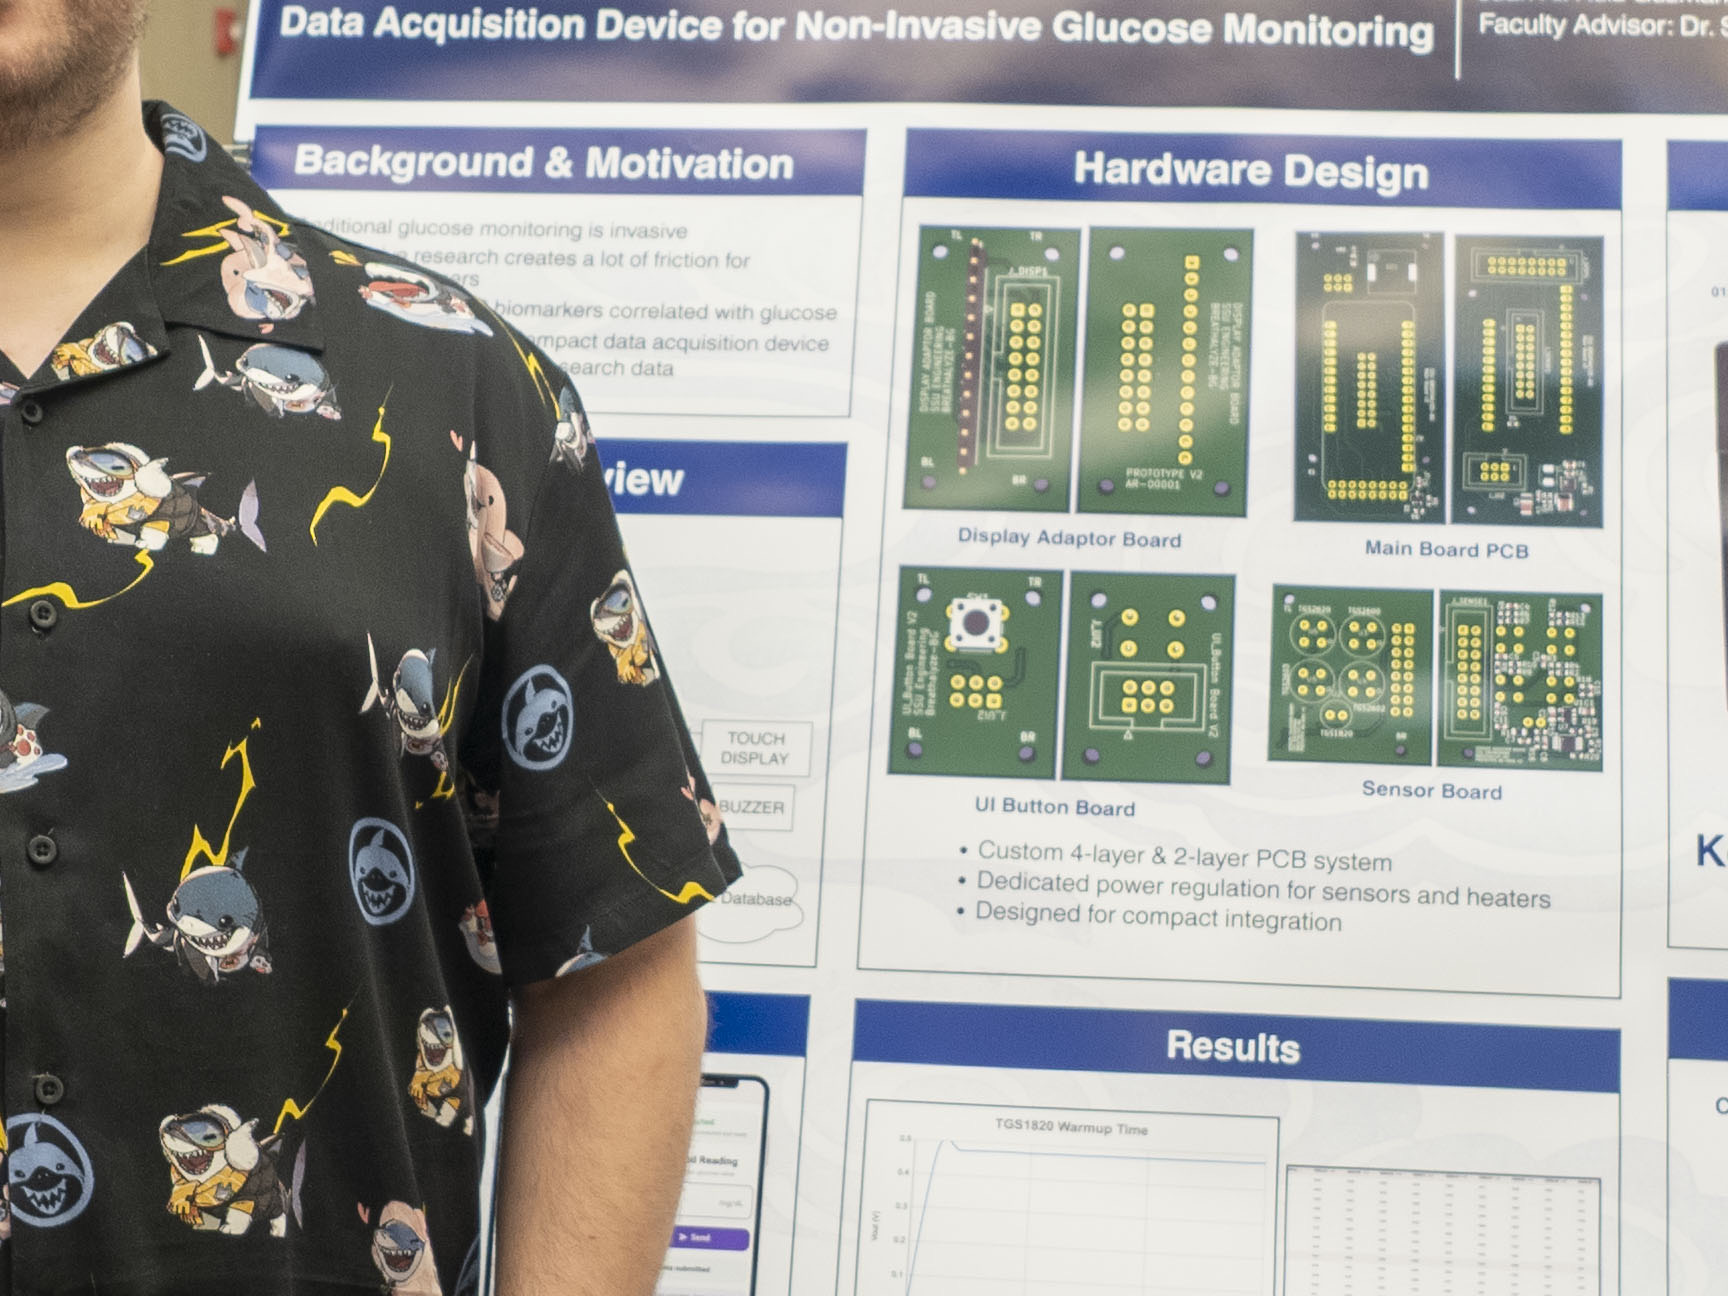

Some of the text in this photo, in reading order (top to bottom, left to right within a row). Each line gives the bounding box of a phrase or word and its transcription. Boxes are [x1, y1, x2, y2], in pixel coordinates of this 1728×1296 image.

[279, 4, 1435, 55] Data Acquisition Device for Non-Invasive Glucose Monitoring
[1479, 11, 1568, 41] Faculty
[1572, 12, 1674, 37] Advisor:
[1679, 14, 1715, 37] Dr.
[294, 143, 794, 185] Background & Motivation
[1074, 150, 1429, 199] Hardware Design
[397, 219, 689, 242] glucose monitoring is invasive
[958, 526, 1182, 550] Display Adaptor Board
[1365, 539, 1530, 560] Main Board PCB
[727, 730, 786, 746] TOUCH
[720, 750, 789, 766] DISPLAY
[1362, 779, 1503, 801] Sensor Board
[717, 799, 786, 816] BUZZER
[975, 796, 1136, 817] UI Button Board
[978, 838, 1393, 876] Custom 4-layer & 2-layer PCB system
[720, 889, 793, 907] Database
[977, 869, 1552, 910] Dedicated power regulation for sensors and heaters
[975, 899, 1343, 935] Designed for compact integration
[1167, 1028, 1301, 1065] Results
[995, 1117, 1149, 1137] TGS1820 Warmup Time
